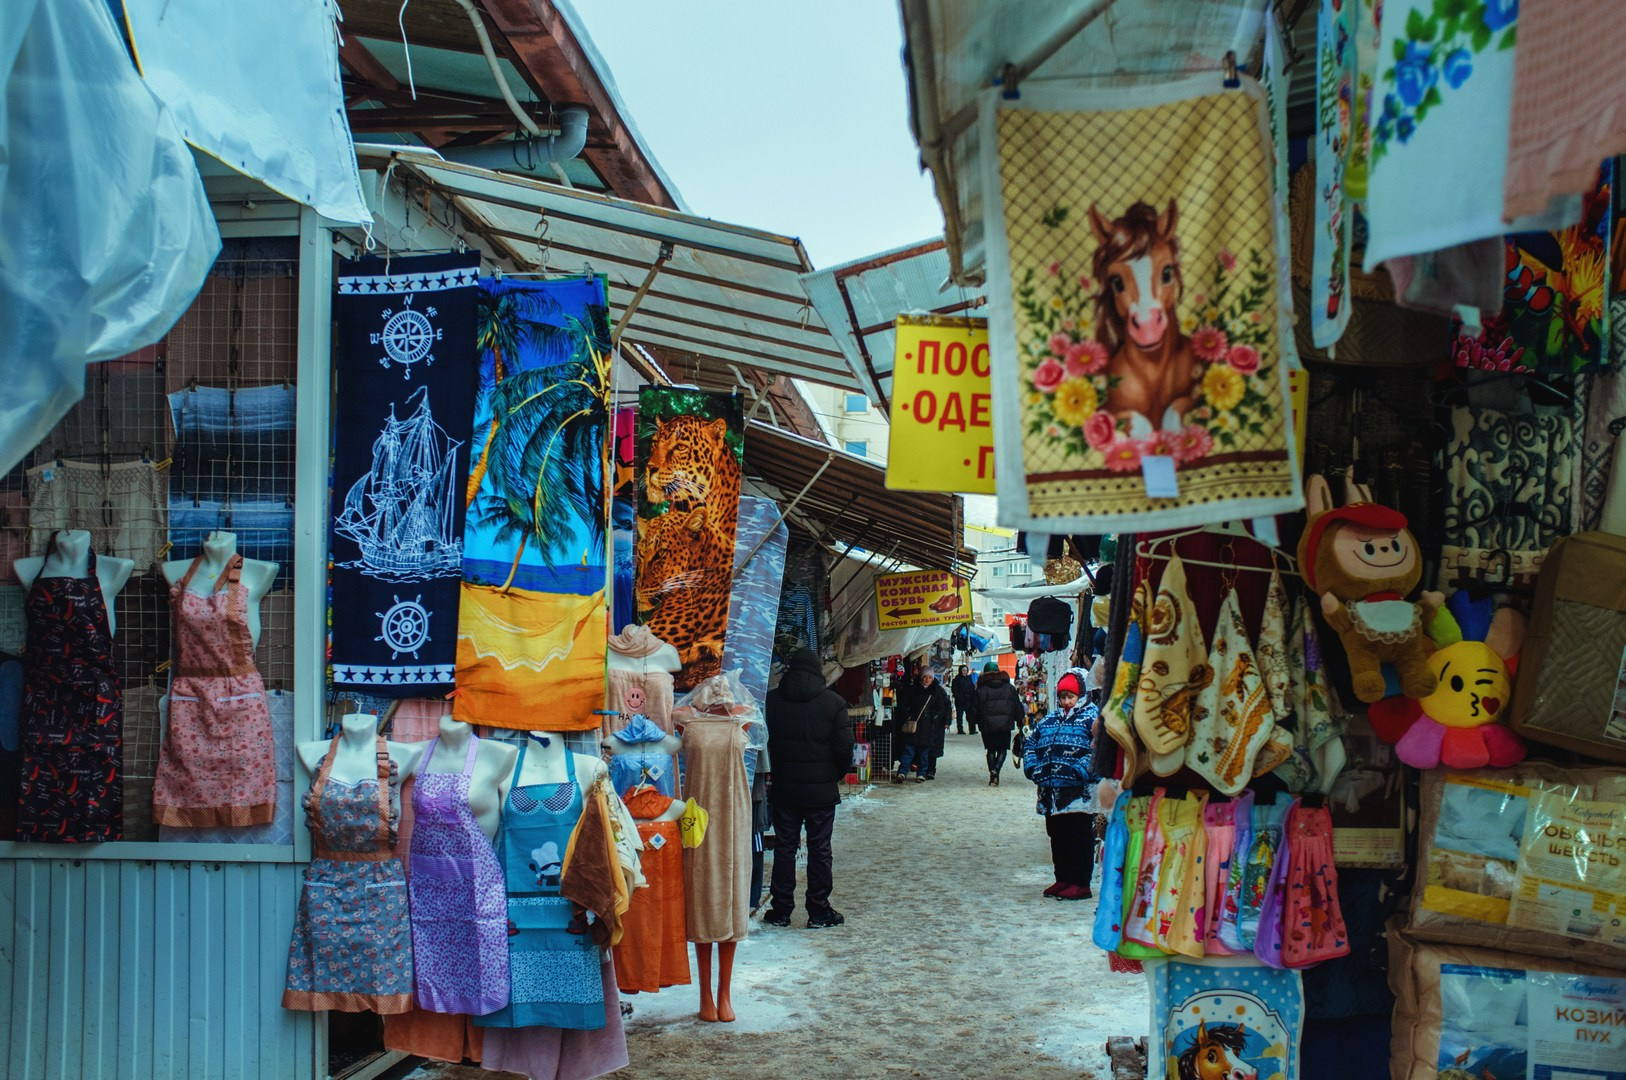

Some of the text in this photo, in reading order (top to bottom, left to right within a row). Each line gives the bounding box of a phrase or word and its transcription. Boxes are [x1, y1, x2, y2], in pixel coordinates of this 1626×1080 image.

[403, 293, 414, 305] N
[436, 328, 443, 340] E
[403, 368, 411, 381] S
[879, 573, 949, 587] МУЖСКАЯ
[880, 583, 949, 597] КОЖАНАЯ
[881, 596, 925, 607] ОБУВЬ
[943, 613, 969, 621] ТУРЦИЯ
[618, 713, 650, 721] HAY
[1576, 1028, 1610, 1043] ПУХ
